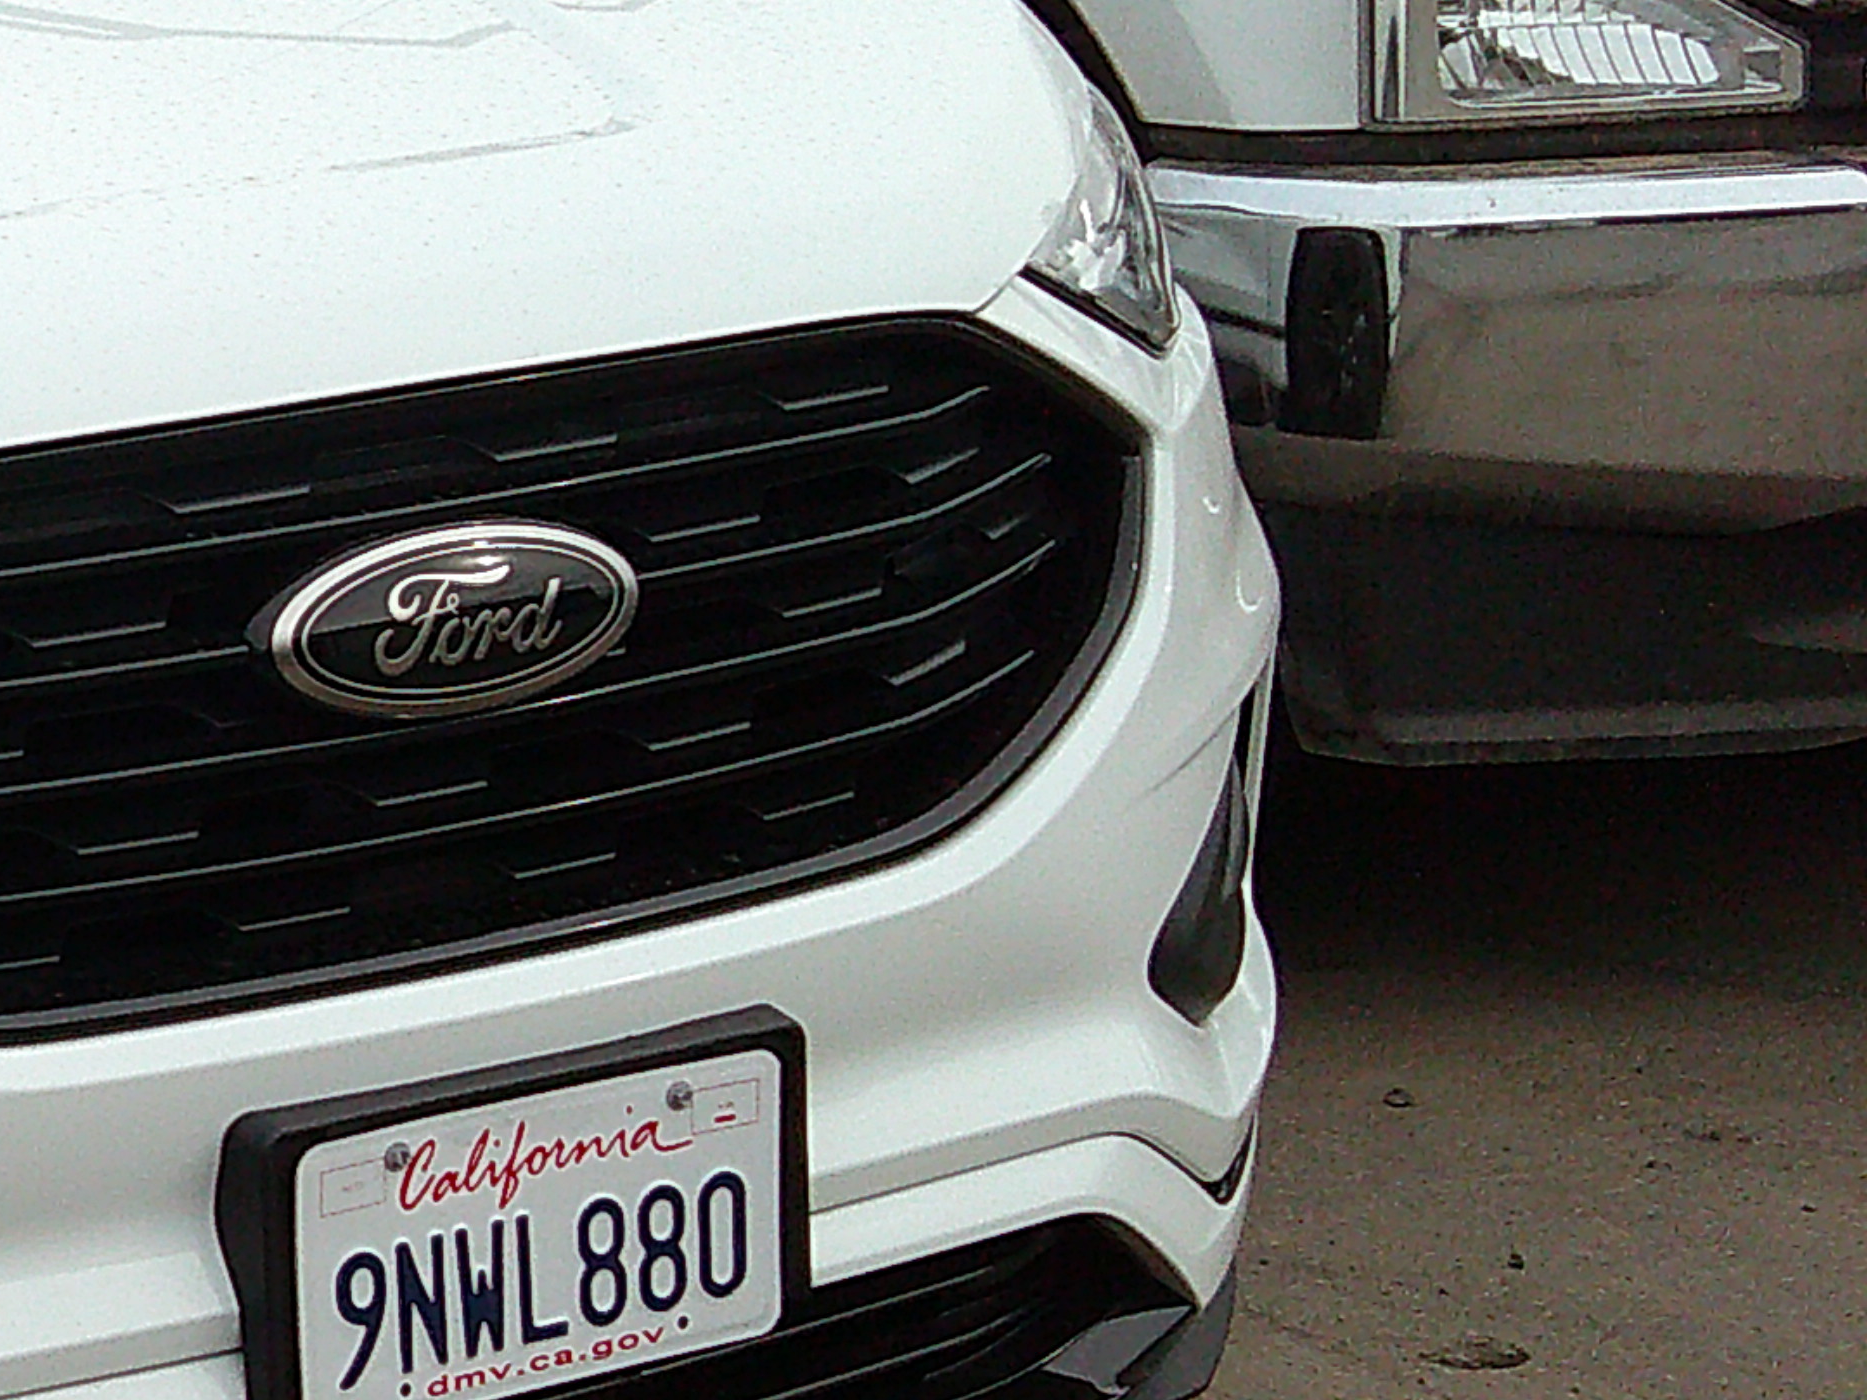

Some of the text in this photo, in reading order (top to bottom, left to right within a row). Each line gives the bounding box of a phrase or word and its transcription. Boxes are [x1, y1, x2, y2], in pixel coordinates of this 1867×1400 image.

[374, 564, 562, 677] Ford
[399, 1104, 693, 1212] California
[334, 1170, 748, 1392] 9NWL880
[426, 1325, 665, 1399] dmv.ca.gov
